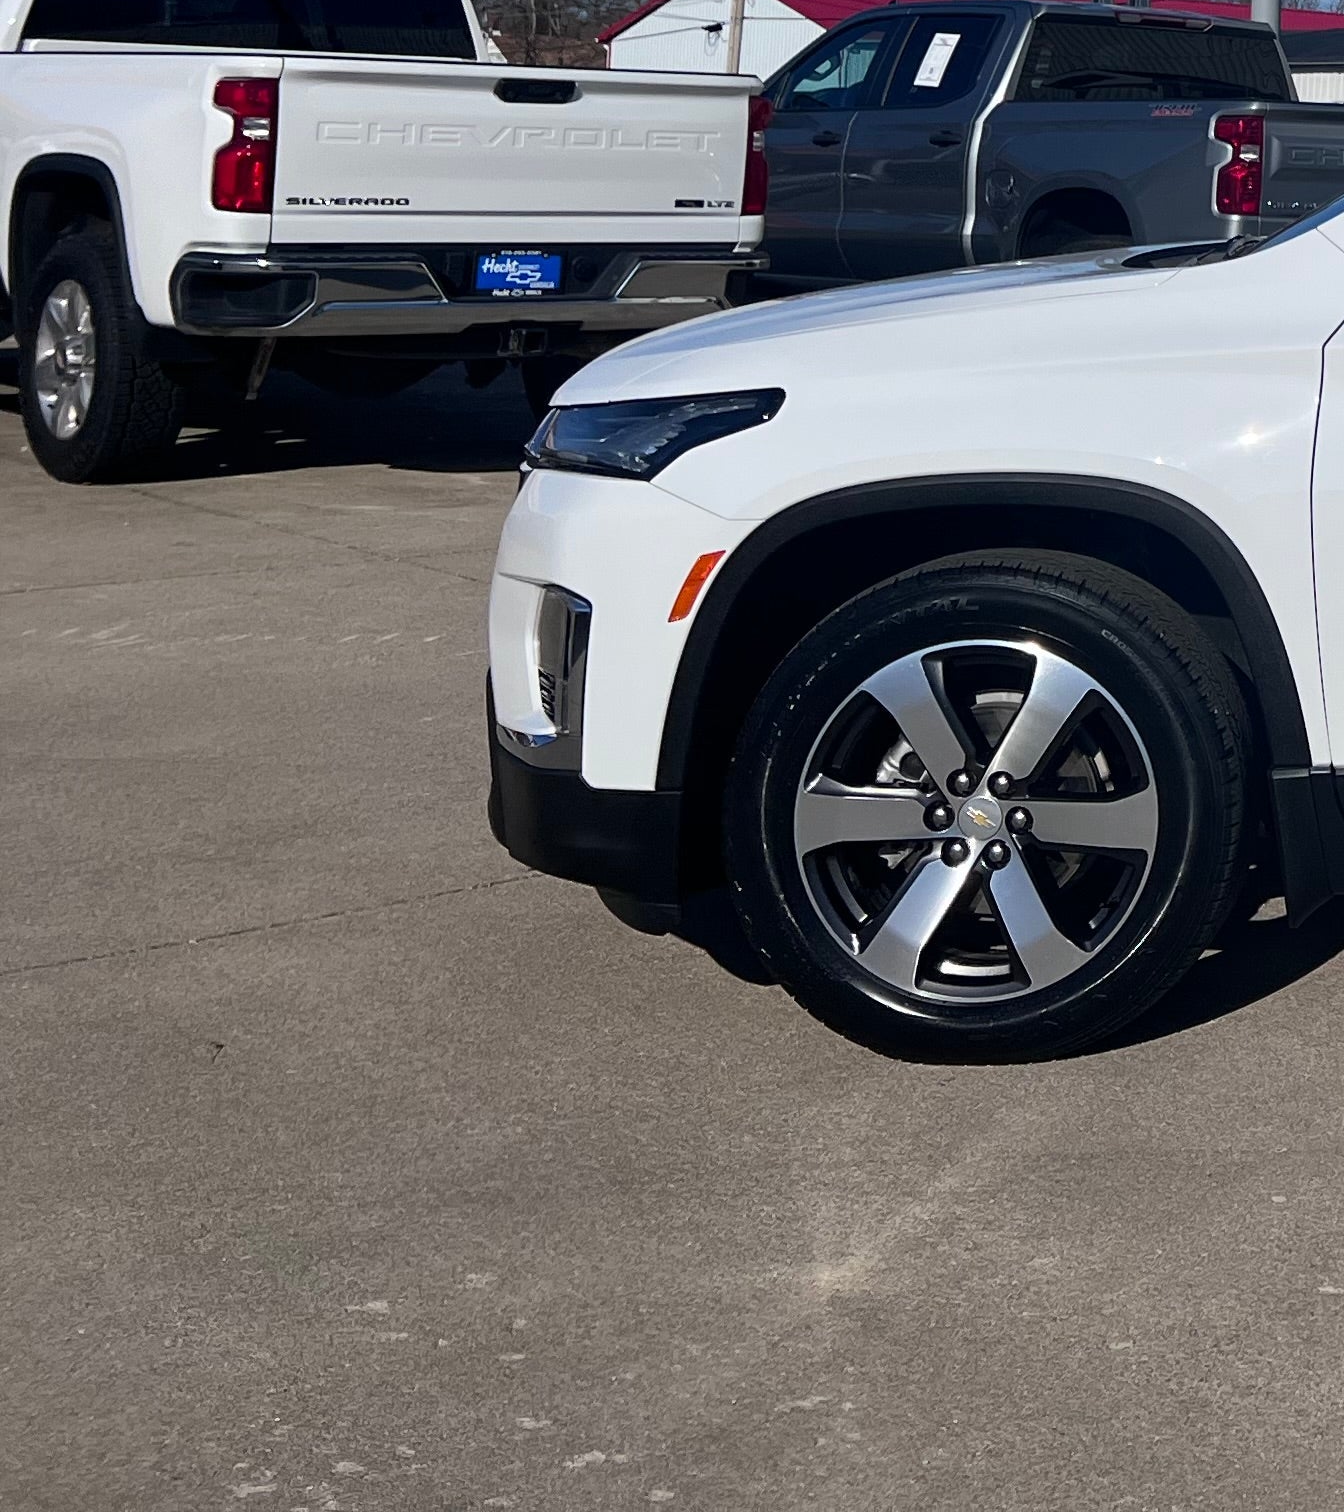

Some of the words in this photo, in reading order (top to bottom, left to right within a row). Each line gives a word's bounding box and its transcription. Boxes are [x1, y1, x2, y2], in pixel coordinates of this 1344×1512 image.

[315, 120, 721, 153] CHEVROLET
[286, 197, 410, 206] SILVERADO
[481, 257, 520, 274] Hecht
